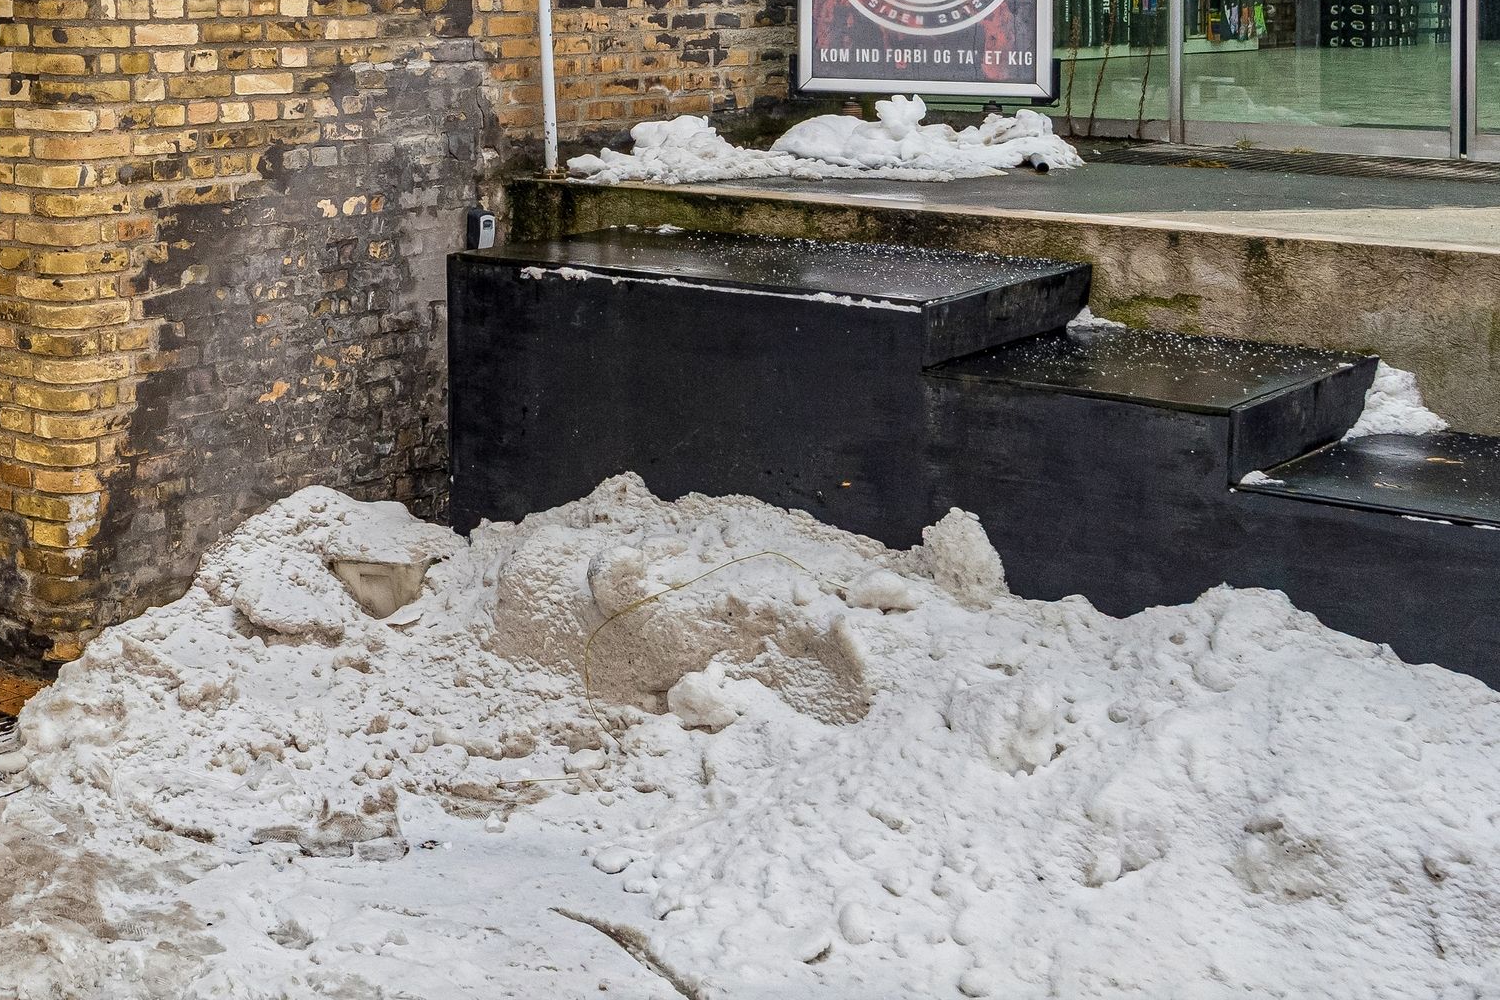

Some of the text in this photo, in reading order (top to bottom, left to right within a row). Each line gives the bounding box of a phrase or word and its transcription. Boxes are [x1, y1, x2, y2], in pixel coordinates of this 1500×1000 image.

[820, 49, 850, 63] KOM
[856, 48, 879, 63] IND
[886, 49, 927, 64] FORBI
[934, 49, 951, 64] OG
[984, 50, 1002, 65] ET
[1008, 51, 1033, 66] KIG
